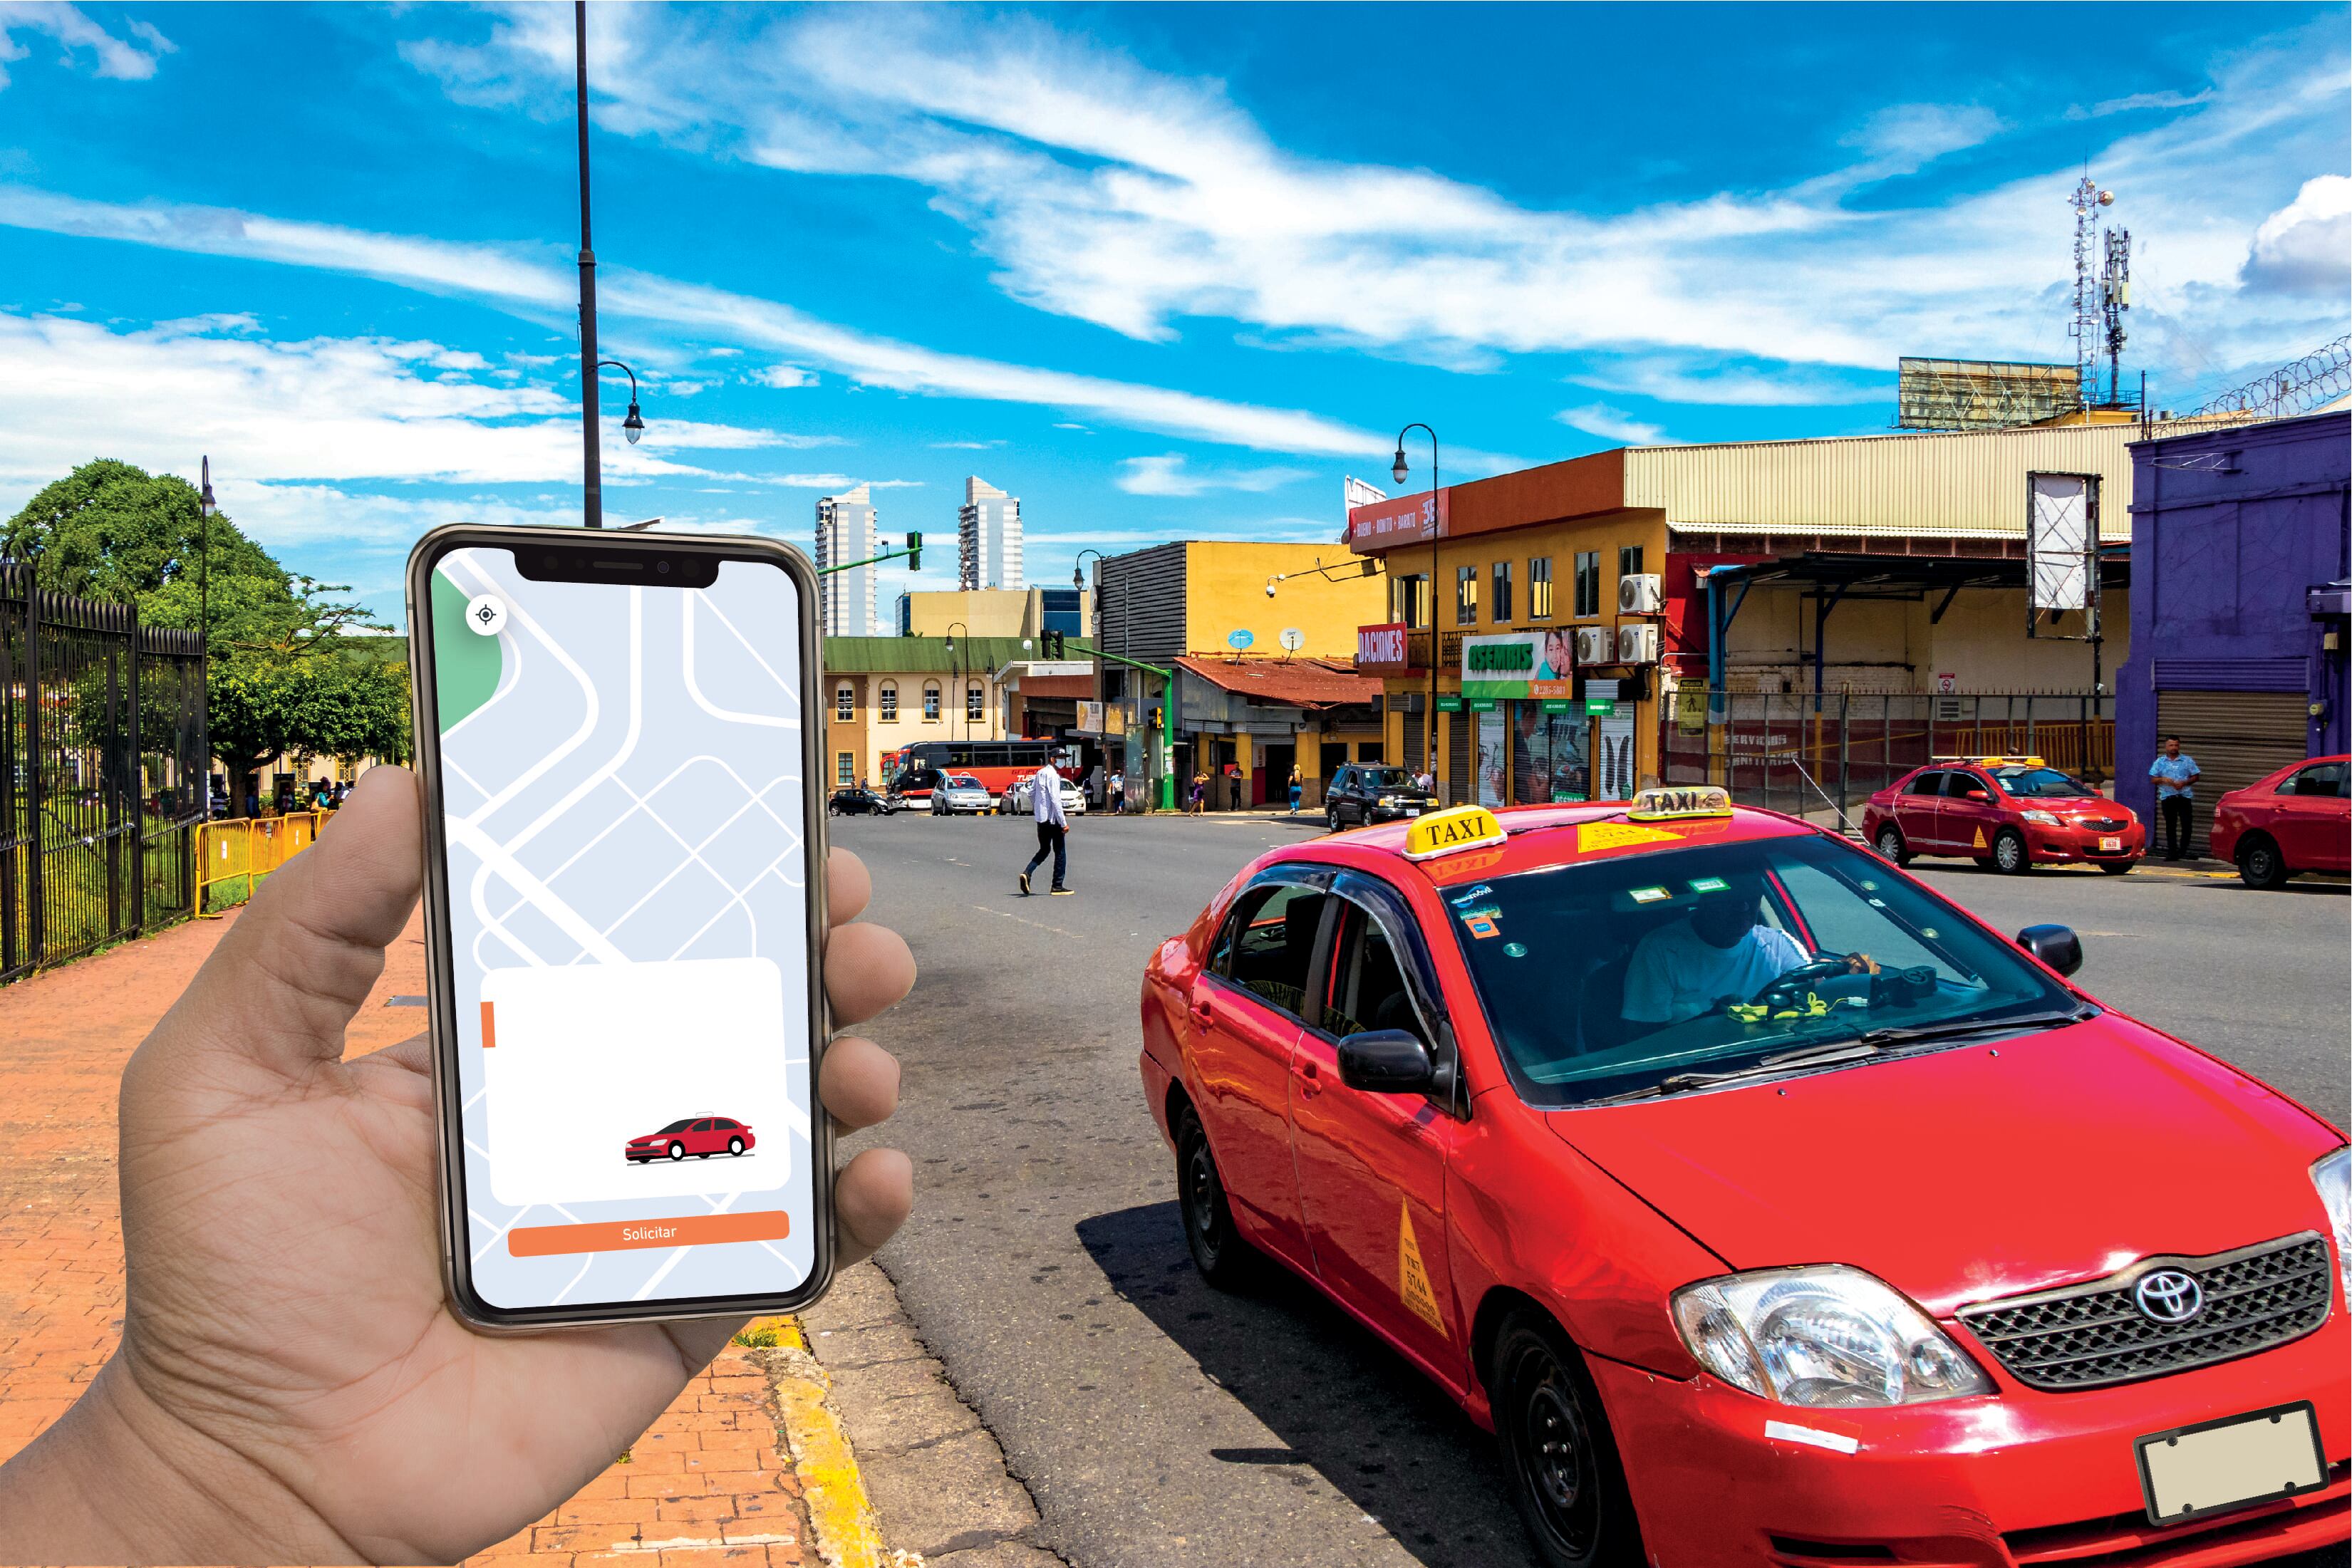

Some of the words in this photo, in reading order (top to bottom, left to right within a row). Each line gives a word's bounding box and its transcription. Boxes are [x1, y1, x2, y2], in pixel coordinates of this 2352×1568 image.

[1357, 521, 1372, 537] BUENO
[1377, 517, 1392, 534] BONITO
[1397, 512, 1416, 530] BARATO
[1358, 630, 1402, 663] DACIONES
[1468, 643, 1533, 670] ASEMBIS
[1645, 791, 1697, 811] TAXI
[1426, 816, 1486, 846] TAXI
[623, 1227, 677, 1240] Solicitar
[1406, 1270, 1427, 1297] 5744
